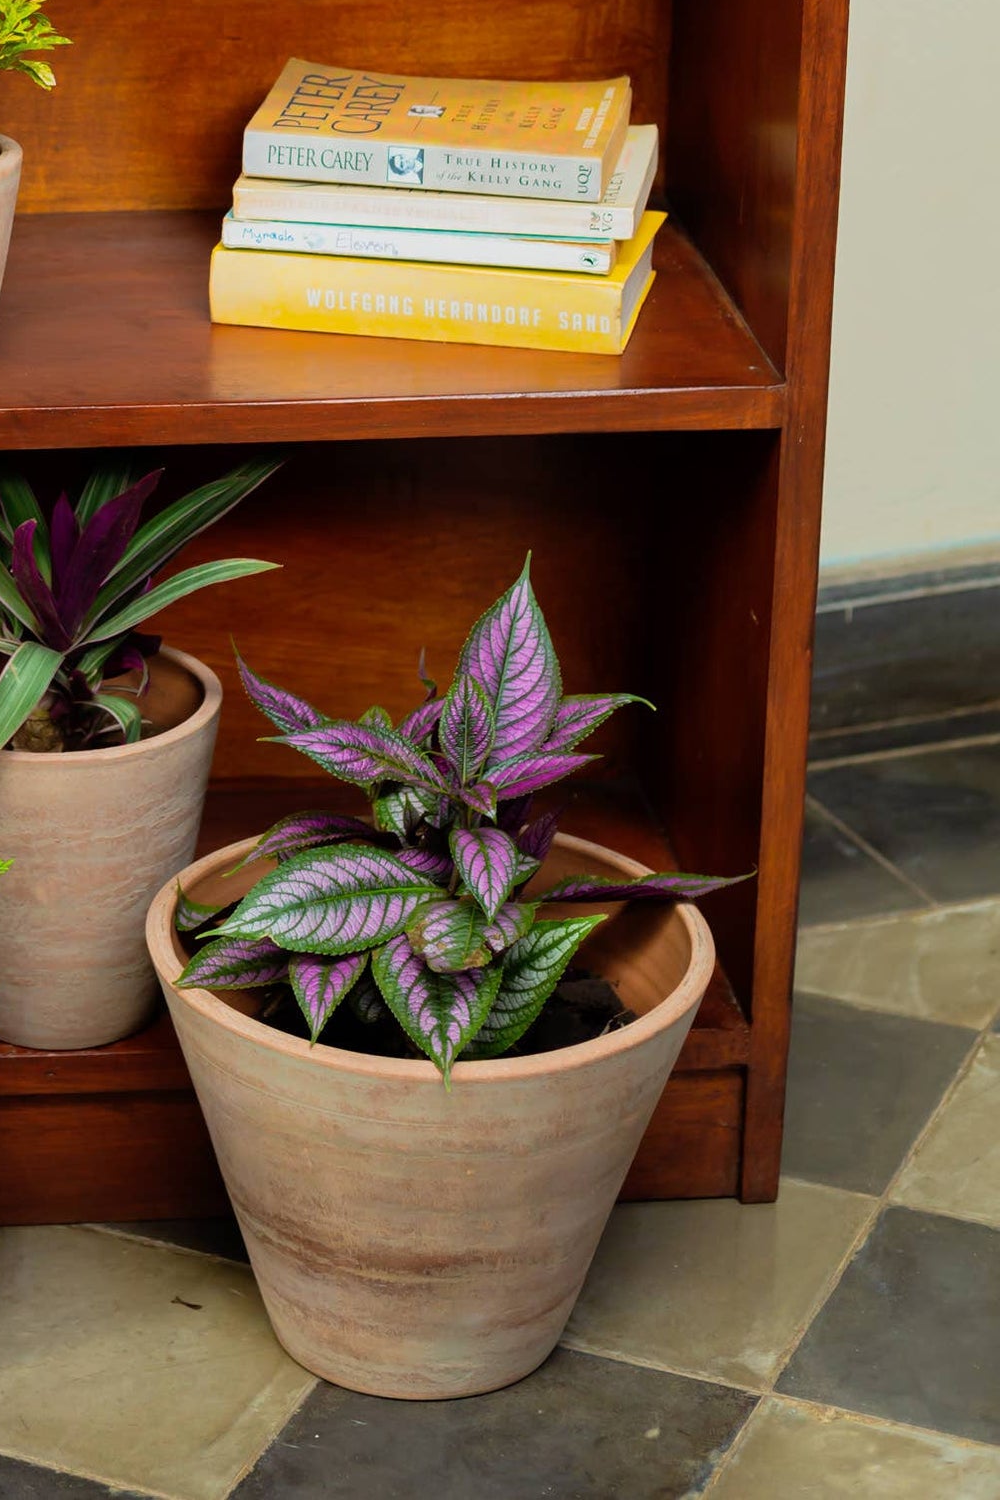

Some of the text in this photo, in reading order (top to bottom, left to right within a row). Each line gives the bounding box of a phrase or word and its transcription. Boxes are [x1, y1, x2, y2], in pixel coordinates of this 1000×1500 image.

[272, 73, 354, 130] PETER
[331, 75, 406, 134] CAREY
[267, 144, 374, 172] PETER CAREY
[443, 153, 558, 174] TRUE HISTORY
[436, 170, 563, 189] of the KELLY GANG
[577, 164, 593, 195] UQP
[306, 287, 611, 334] WOLFGANG HERRNDORF SAND
